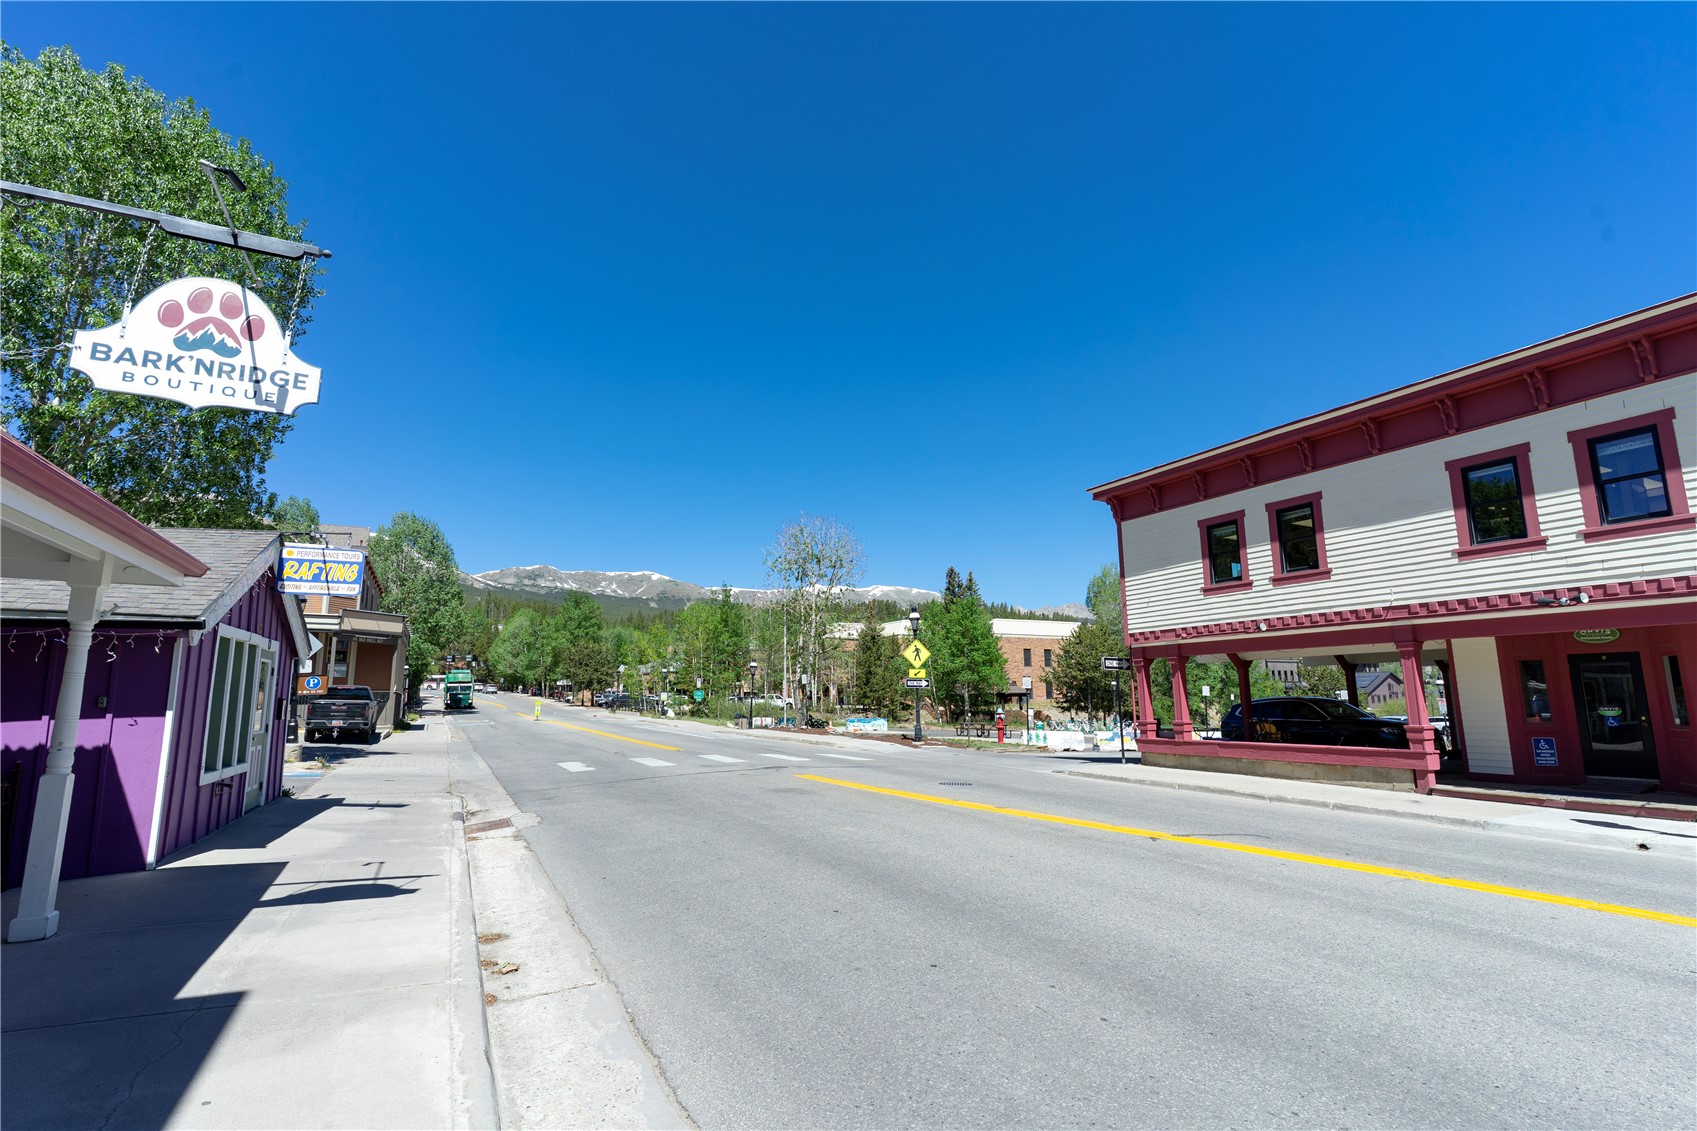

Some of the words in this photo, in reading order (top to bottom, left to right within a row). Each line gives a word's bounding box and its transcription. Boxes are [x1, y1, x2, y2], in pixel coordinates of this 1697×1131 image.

[89, 341, 310, 391] BARK'NRIDGE
[121, 371, 277, 403] BOUTIQUE
[296, 550, 341, 560] PERFORMANCE
[341, 552, 361, 561] TOURS
[282, 560, 360, 582] RAFTING
[309, 678, 318, 687] P
